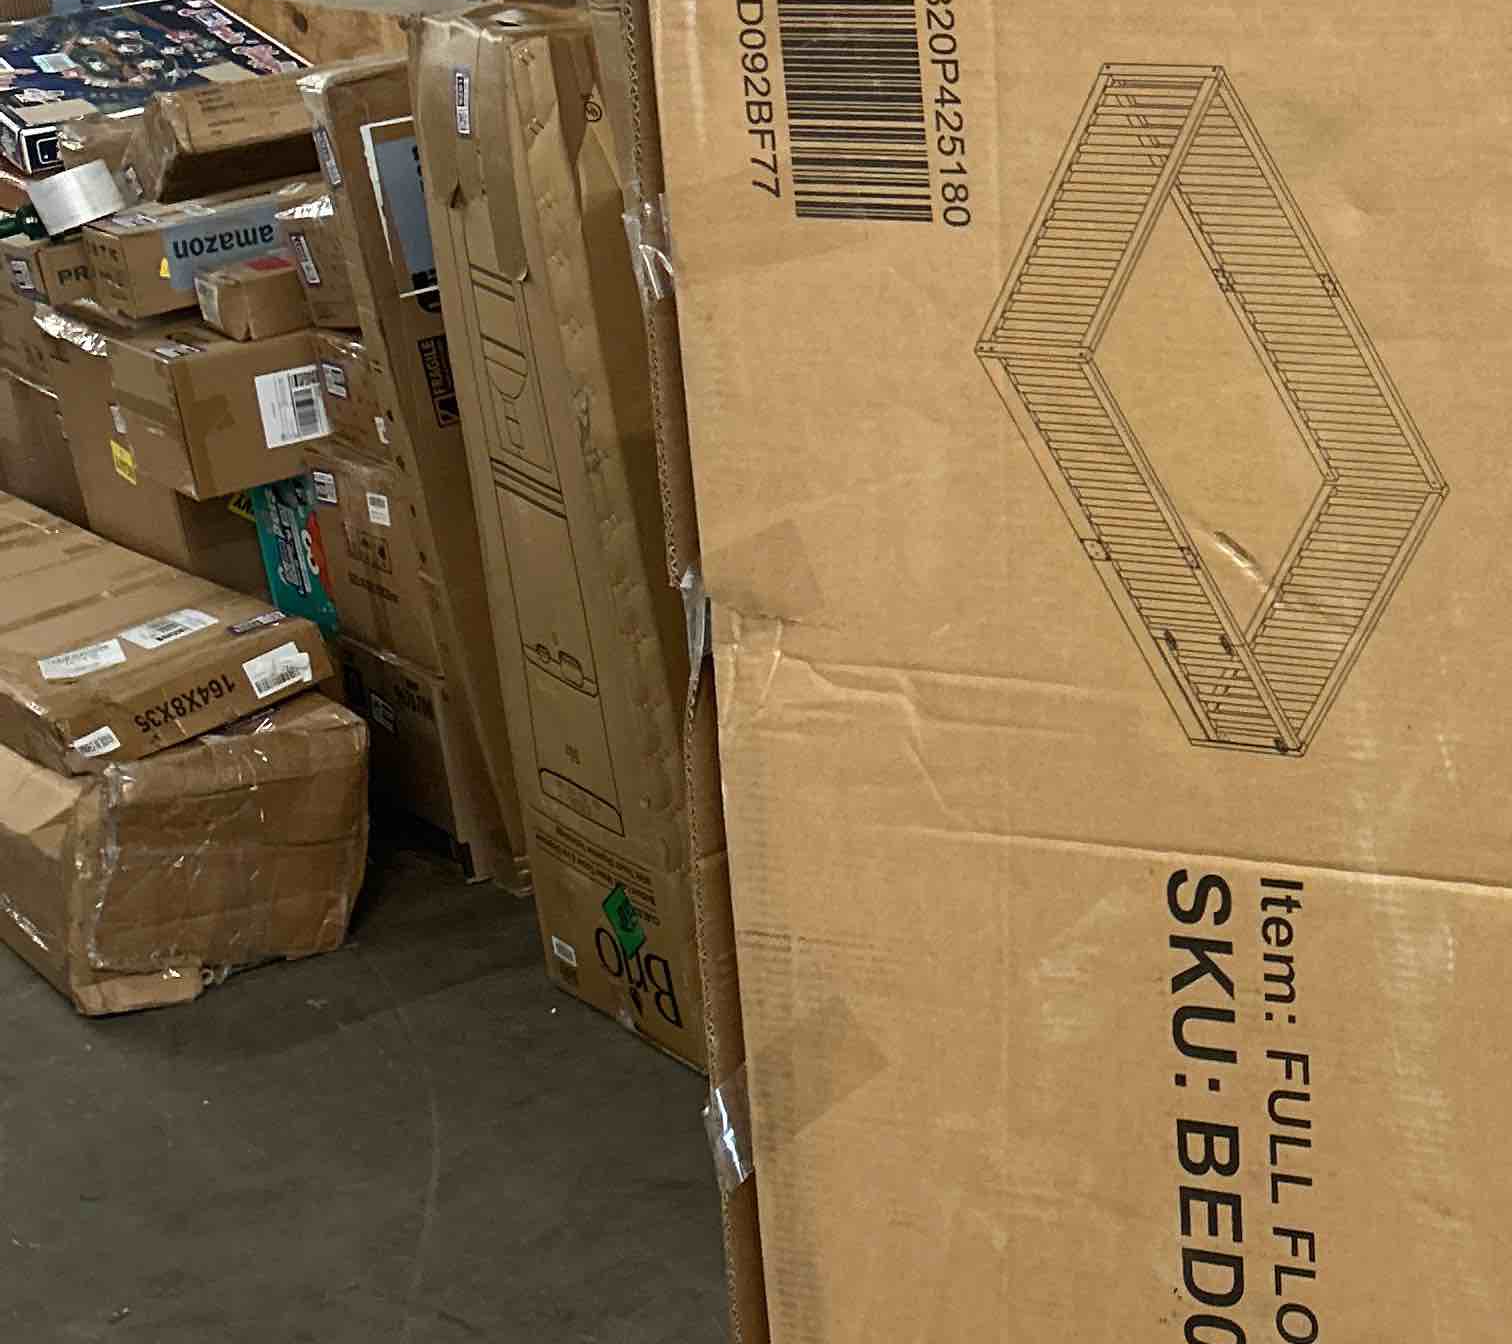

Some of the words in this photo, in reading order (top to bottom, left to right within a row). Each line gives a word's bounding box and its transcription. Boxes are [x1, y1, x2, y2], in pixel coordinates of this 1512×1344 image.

[173, 222, 275, 259] amazon
[1167, 870, 1236, 1093] SKU:
[1258, 875, 1304, 1025] Item:
[1263, 1048, 1314, 1202] FULL
